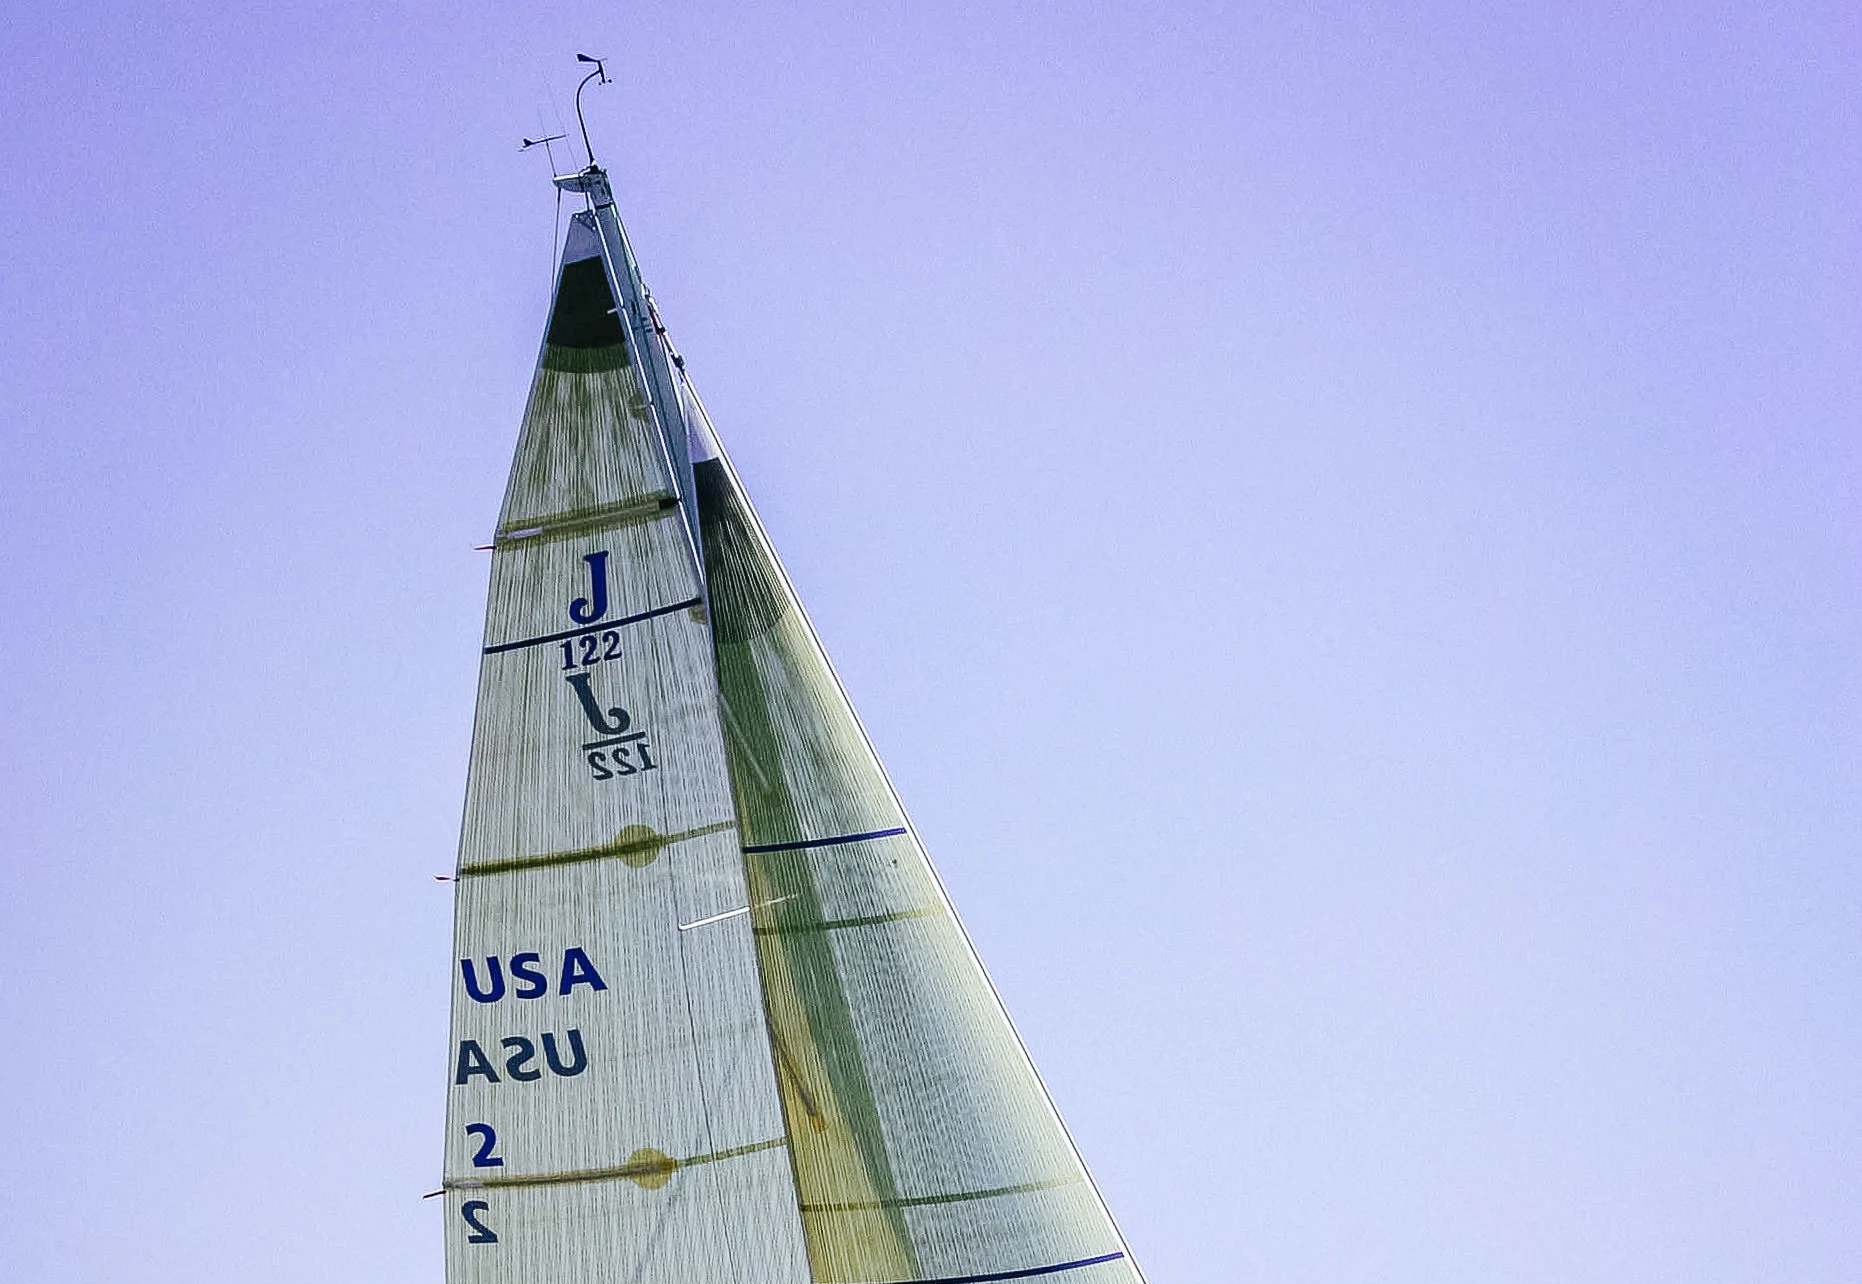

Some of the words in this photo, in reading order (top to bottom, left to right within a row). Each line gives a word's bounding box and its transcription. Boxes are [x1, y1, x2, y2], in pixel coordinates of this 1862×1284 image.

[569, 550, 609, 624] J
[560, 630, 622, 670] 122
[460, 946, 608, 1004] USA
[465, 1122, 504, 1168] 2
